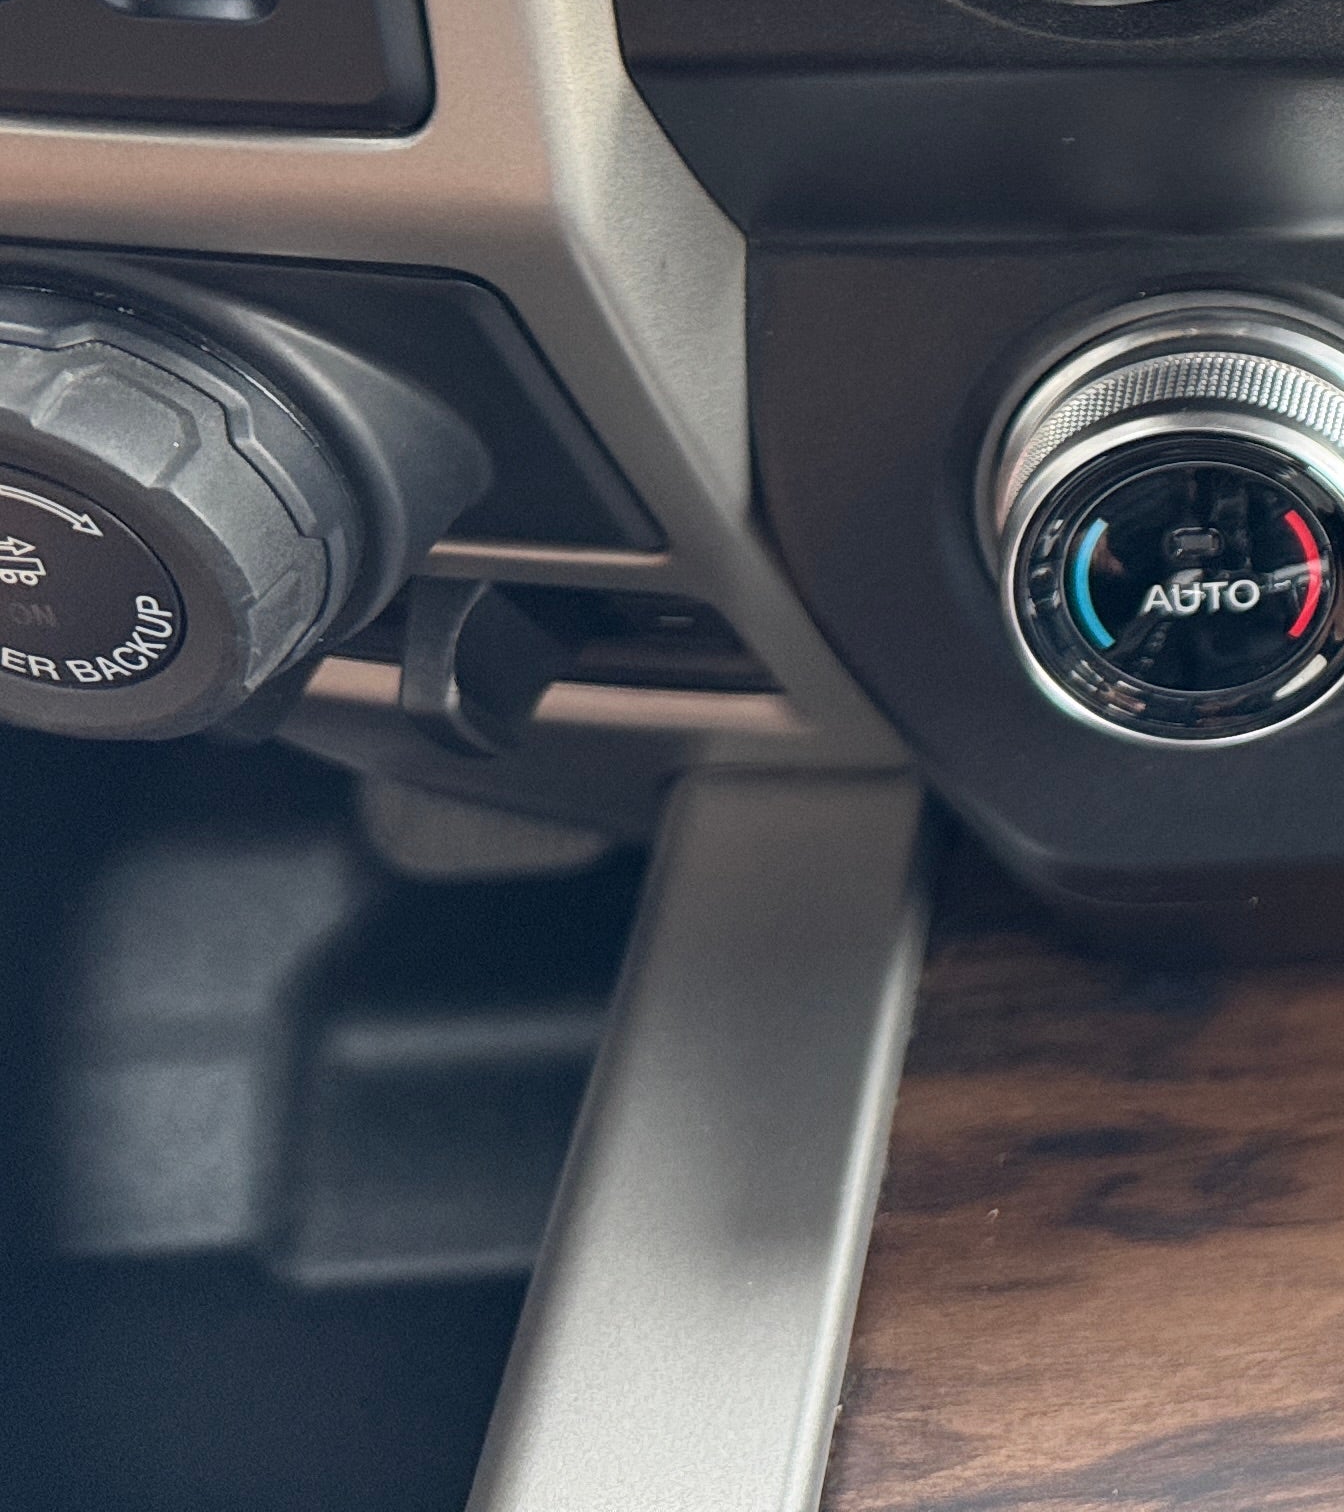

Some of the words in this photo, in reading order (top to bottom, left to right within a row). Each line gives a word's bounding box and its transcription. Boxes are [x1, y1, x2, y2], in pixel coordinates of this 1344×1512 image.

[1143, 579, 1261, 616] AUTO
[1, 646, 61, 681] ER
[65, 595, 173, 683] BACKUP
